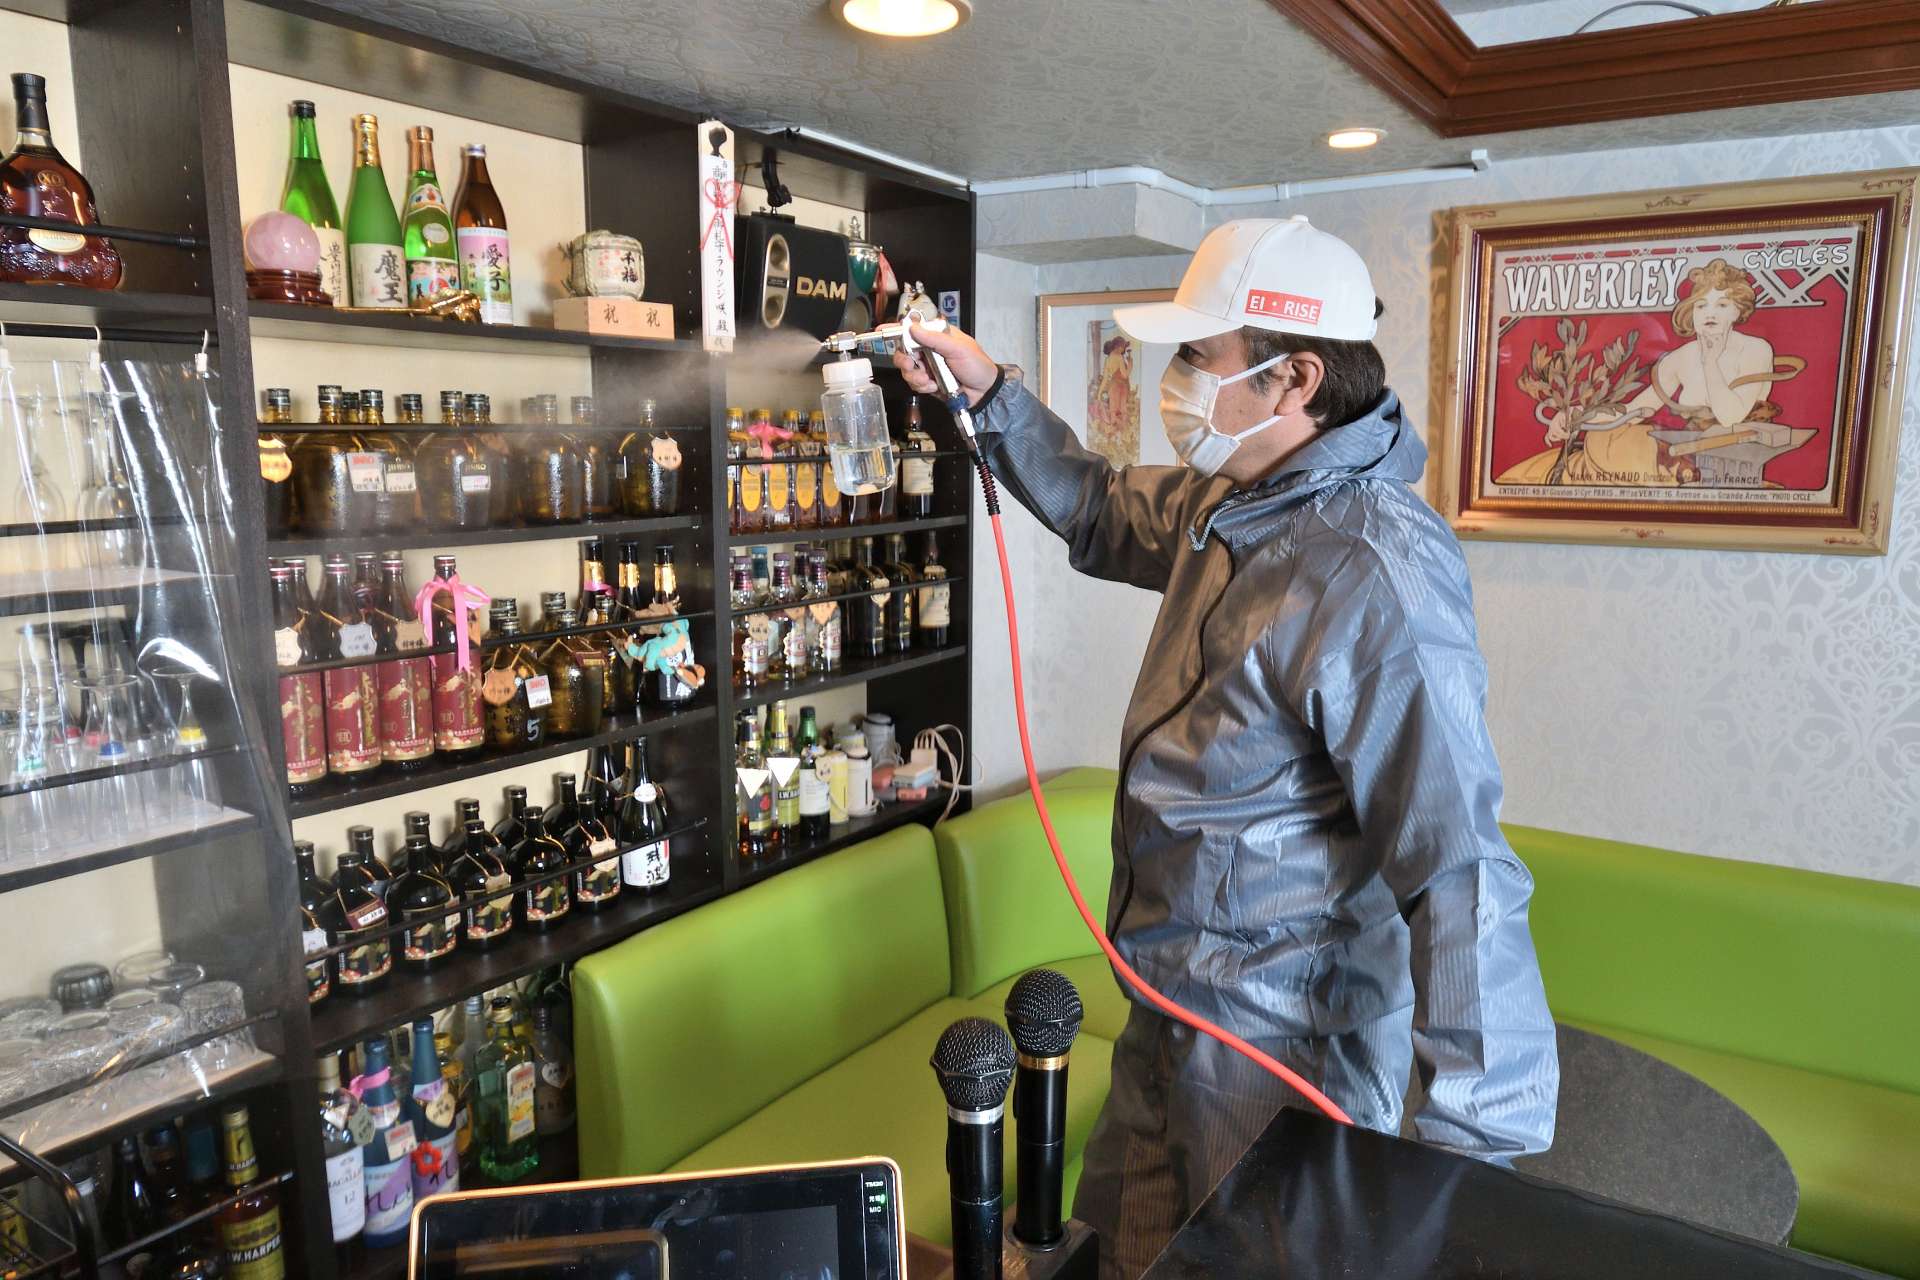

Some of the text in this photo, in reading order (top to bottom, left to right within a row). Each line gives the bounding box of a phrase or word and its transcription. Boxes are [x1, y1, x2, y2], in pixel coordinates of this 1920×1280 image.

[374, 249, 403, 304] 魔王
[487, 243, 506, 292] 愛子
[620, 250, 639, 283] 千福
[1502, 244, 1850, 313] WAVERLEY CYCLES
[795, 276, 848, 301] DAM
[603, 303, 619, 324] 祝
[646, 307, 661, 327] 祝
[1283, 300, 1320, 321] RISE
[1596, 471, 1640, 482] REYNAUD
